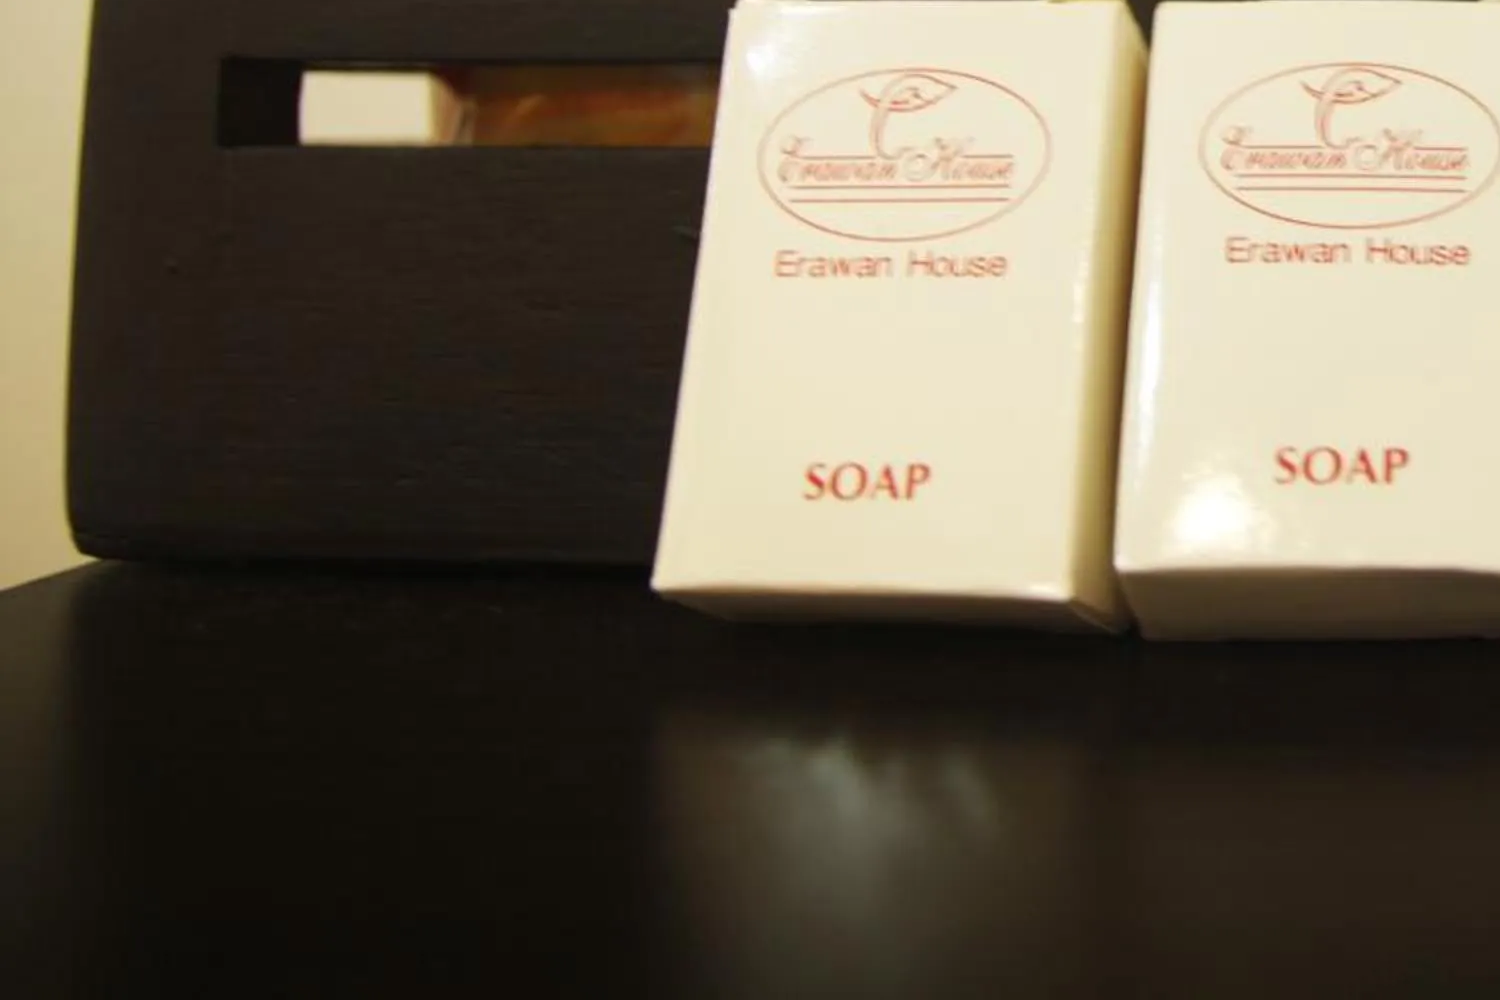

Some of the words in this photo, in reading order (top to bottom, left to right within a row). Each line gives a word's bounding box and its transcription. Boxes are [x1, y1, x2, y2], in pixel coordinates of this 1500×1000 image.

[773, 248, 895, 279] Erawan
[905, 248, 1009, 280] House
[1225, 235, 1350, 265] Erawan
[1365, 237, 1472, 266] House
[803, 460, 932, 503] SOAP
[1273, 444, 1410, 487] SOAP
